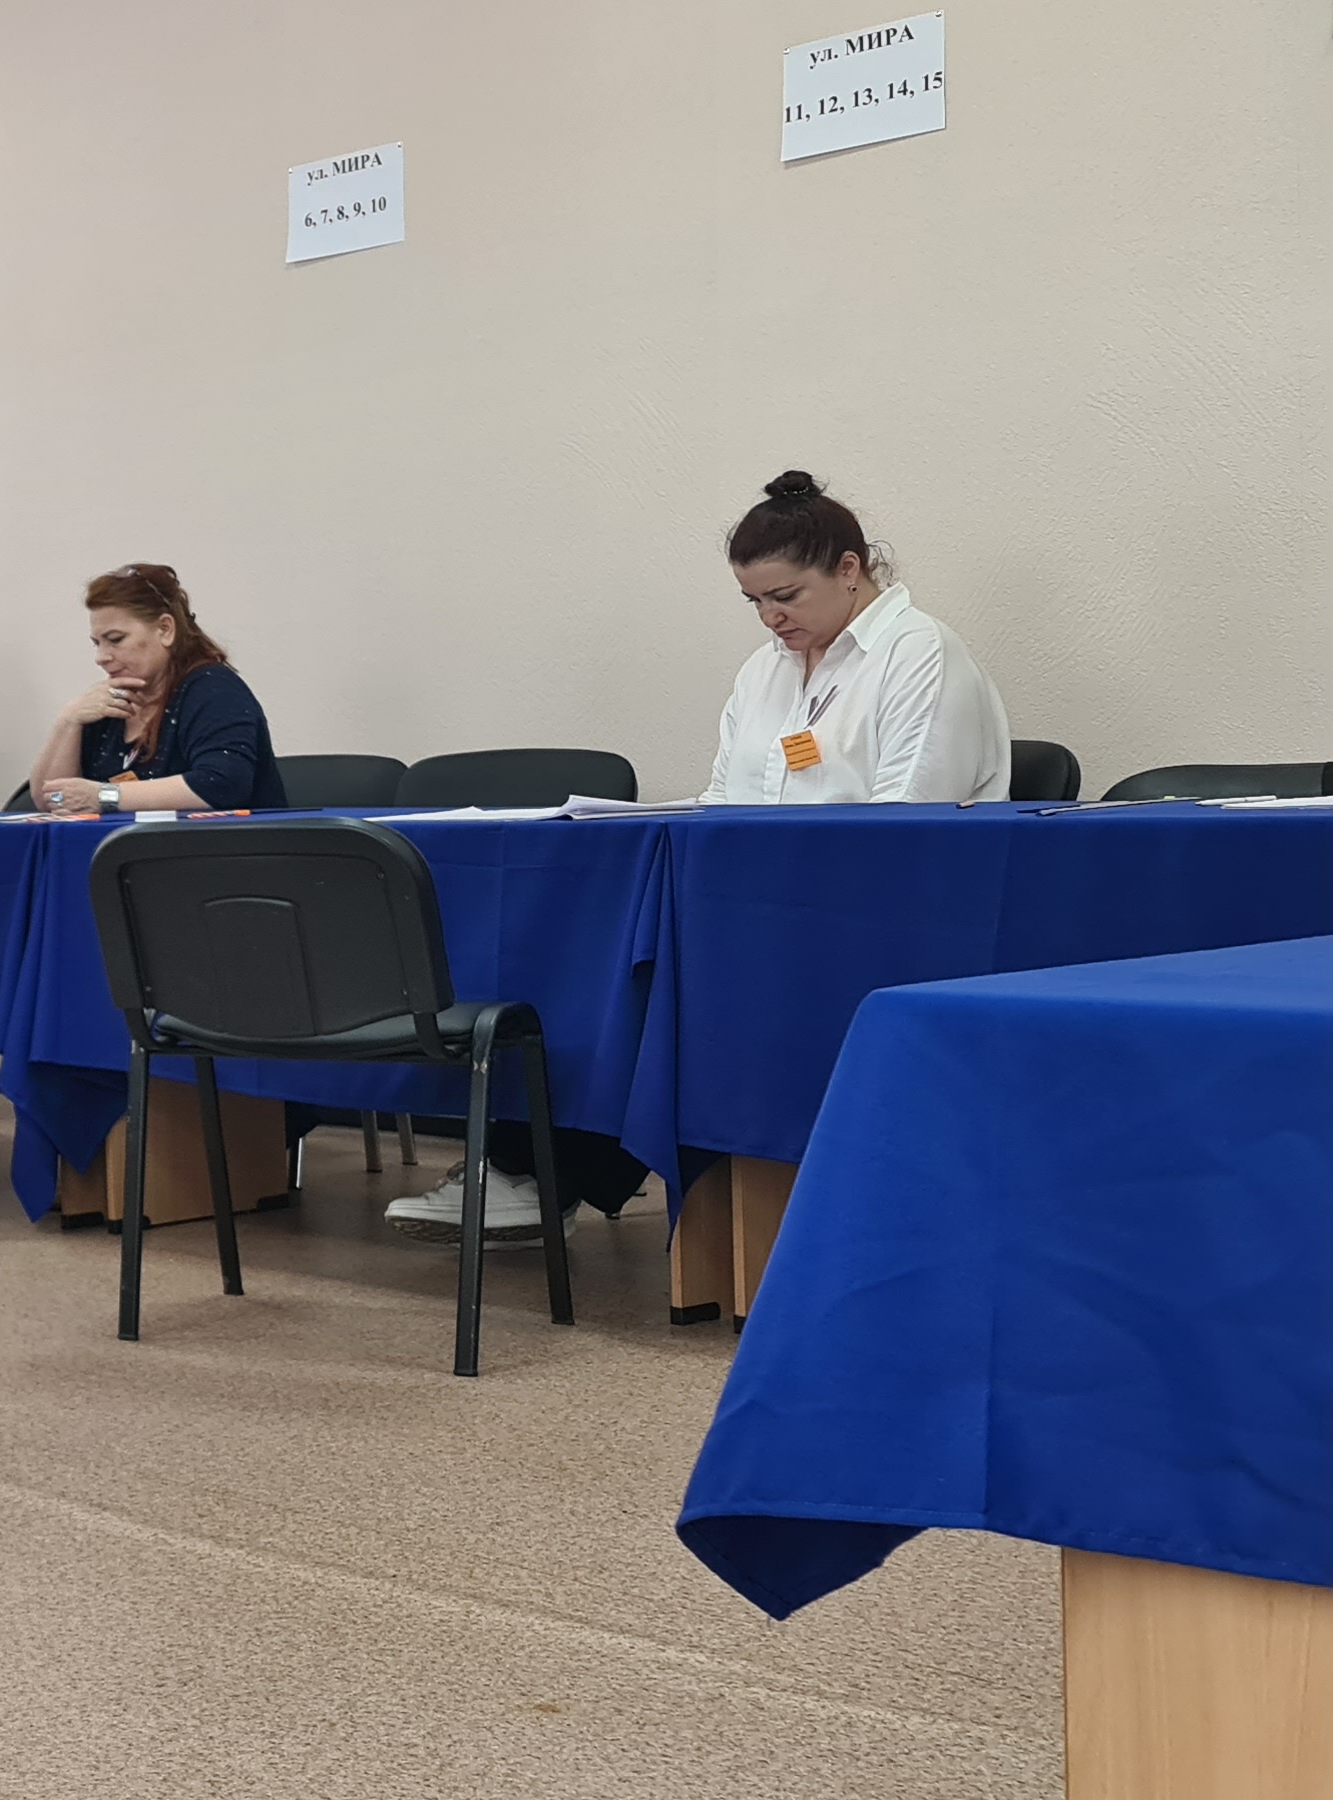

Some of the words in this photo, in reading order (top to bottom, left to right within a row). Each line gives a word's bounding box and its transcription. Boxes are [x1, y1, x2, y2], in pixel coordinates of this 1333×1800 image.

[809, 48, 839, 69] ул.
[844, 24, 915, 56] МИРА
[784, 104, 811, 124] 11,
[818, 96, 845, 116] 12,
[852, 88, 880, 109] 13,
[886, 79, 915, 100] 14,
[922, 71, 943, 93] 15
[307, 169, 328, 186] ул.
[332, 152, 383, 176] МИРА
[304, 212, 317, 228] 6,
[320, 209, 333, 225] 7,
[336, 205, 349, 221] 8,
[353, 202, 366, 217] 9,
[371, 196, 387, 213] 10
